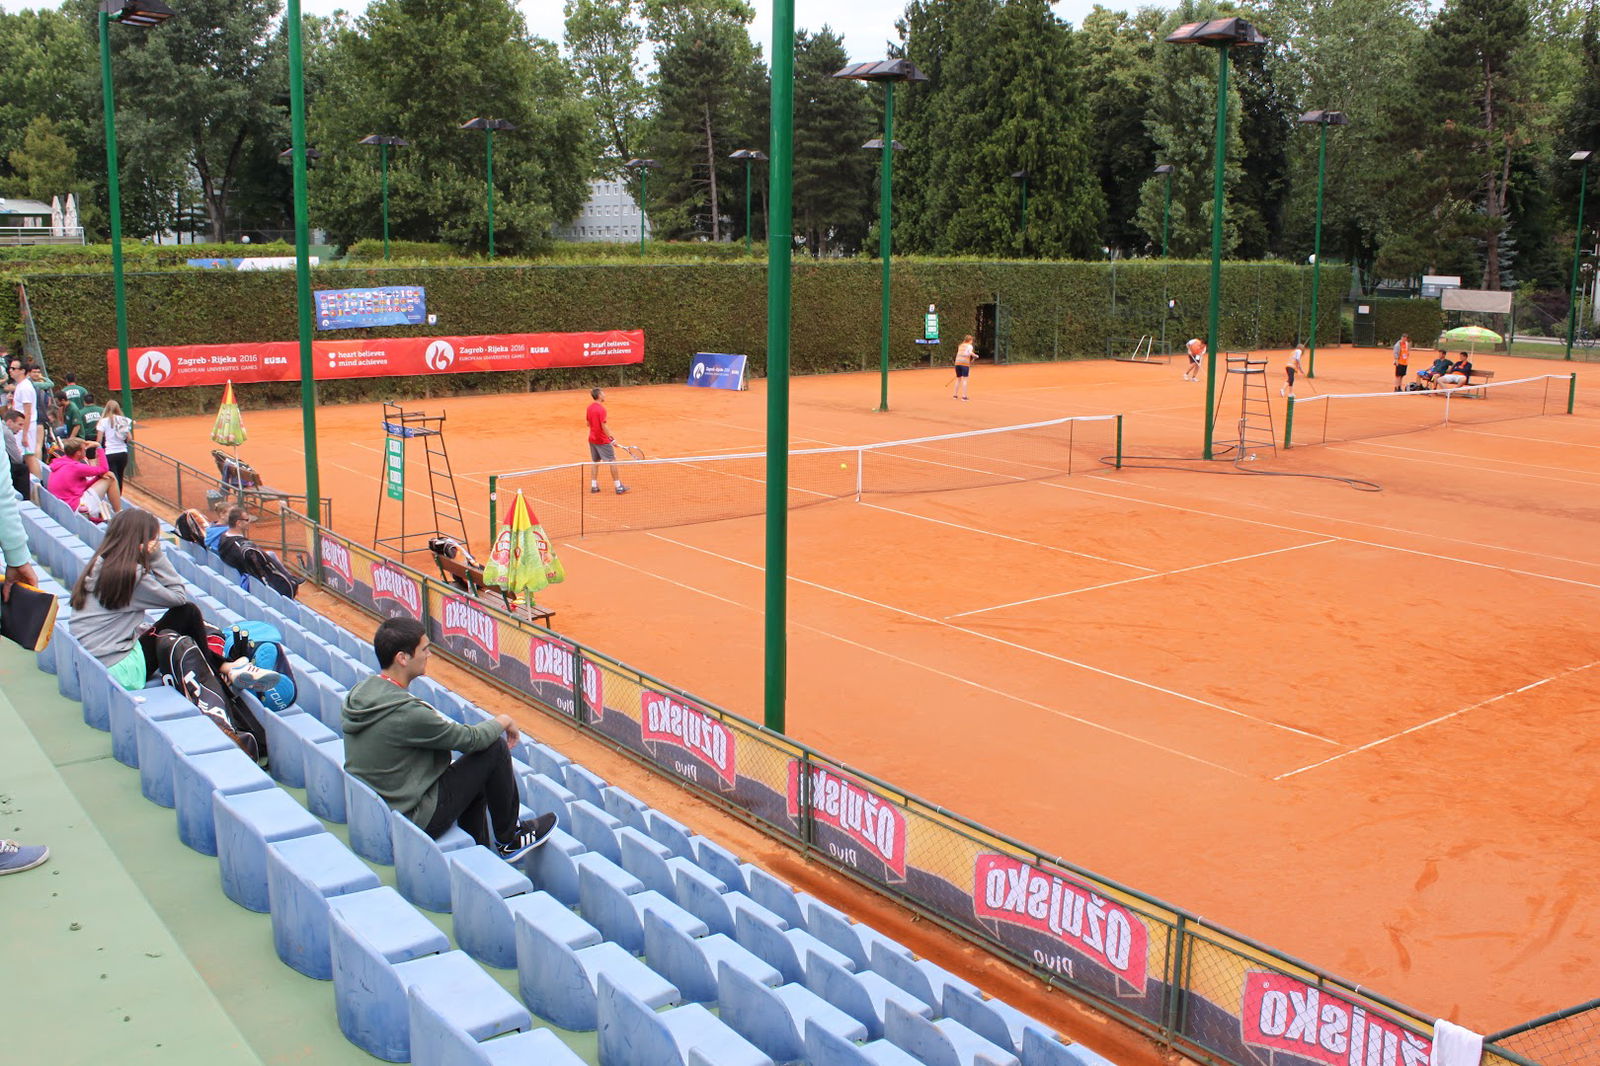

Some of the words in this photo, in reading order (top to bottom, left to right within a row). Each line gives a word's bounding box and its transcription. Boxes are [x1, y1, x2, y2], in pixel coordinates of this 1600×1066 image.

[459, 346, 484, 355] Zagreb
[488, 345, 508, 354] Rijeka
[178, 357, 206, 366] Zagreb
[211, 356, 237, 364] Rijeka
[264, 356, 288, 364] EUSA
[338, 358, 357, 366] mind
